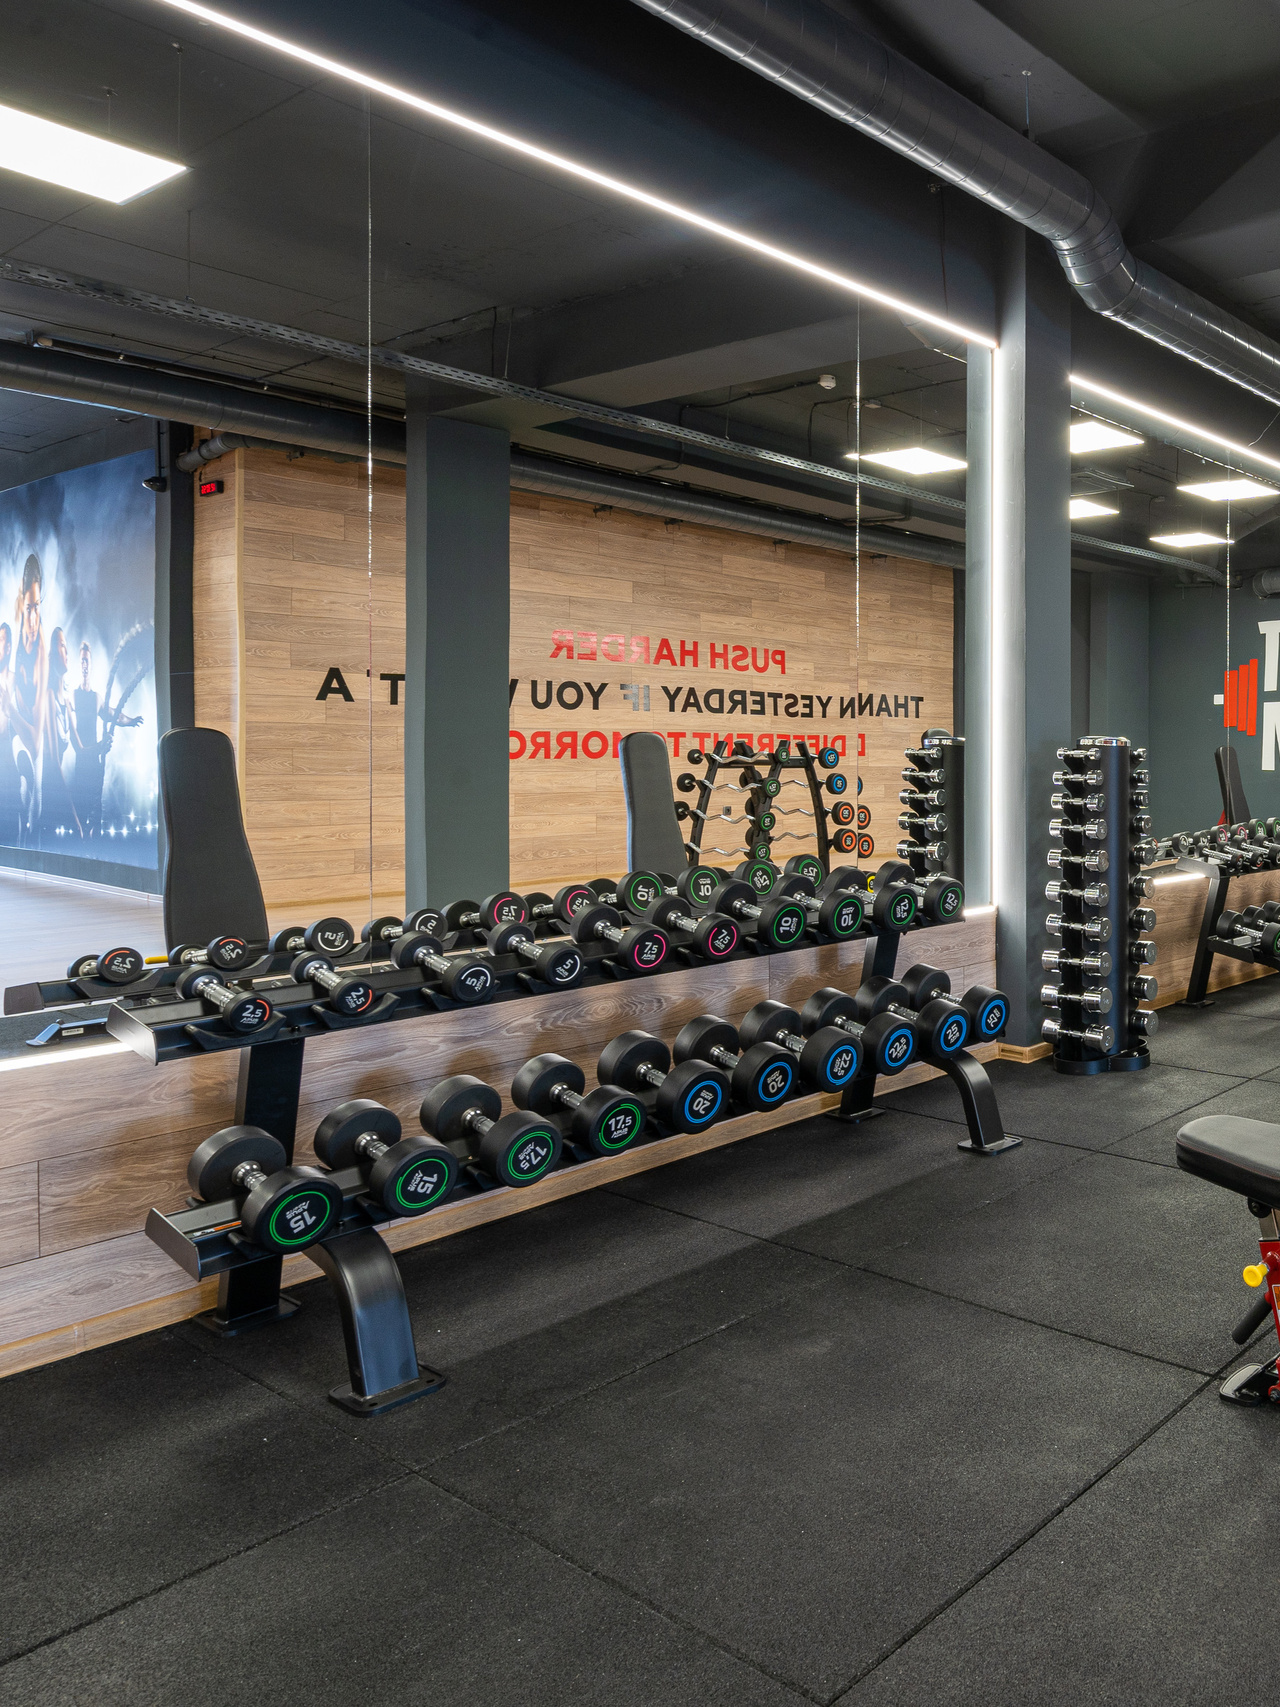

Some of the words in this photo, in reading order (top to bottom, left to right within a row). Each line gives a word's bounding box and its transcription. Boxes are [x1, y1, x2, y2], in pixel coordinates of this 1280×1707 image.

[780, 917, 792, 933] 10
[841, 914, 854, 927] 10
[717, 929, 730, 944] 7,5
[644, 942, 659, 954] 7,5
[563, 958, 574, 970] 5
[466, 977, 477, 987] 5
[351, 987, 365, 1005] 2,5
[242, 1004, 263, 1018] 2,5
[987, 1013, 998, 1028] 25
[946, 1023, 959, 1040] 25
[768, 1075, 785, 1094] 20
[693, 1097, 711, 1114] 20
[608, 1115, 632, 1131] 17,5
[520, 1146, 547, 1170] 17,5
[417, 1173, 438, 1194] 15
[289, 1211, 317, 1234] 15
